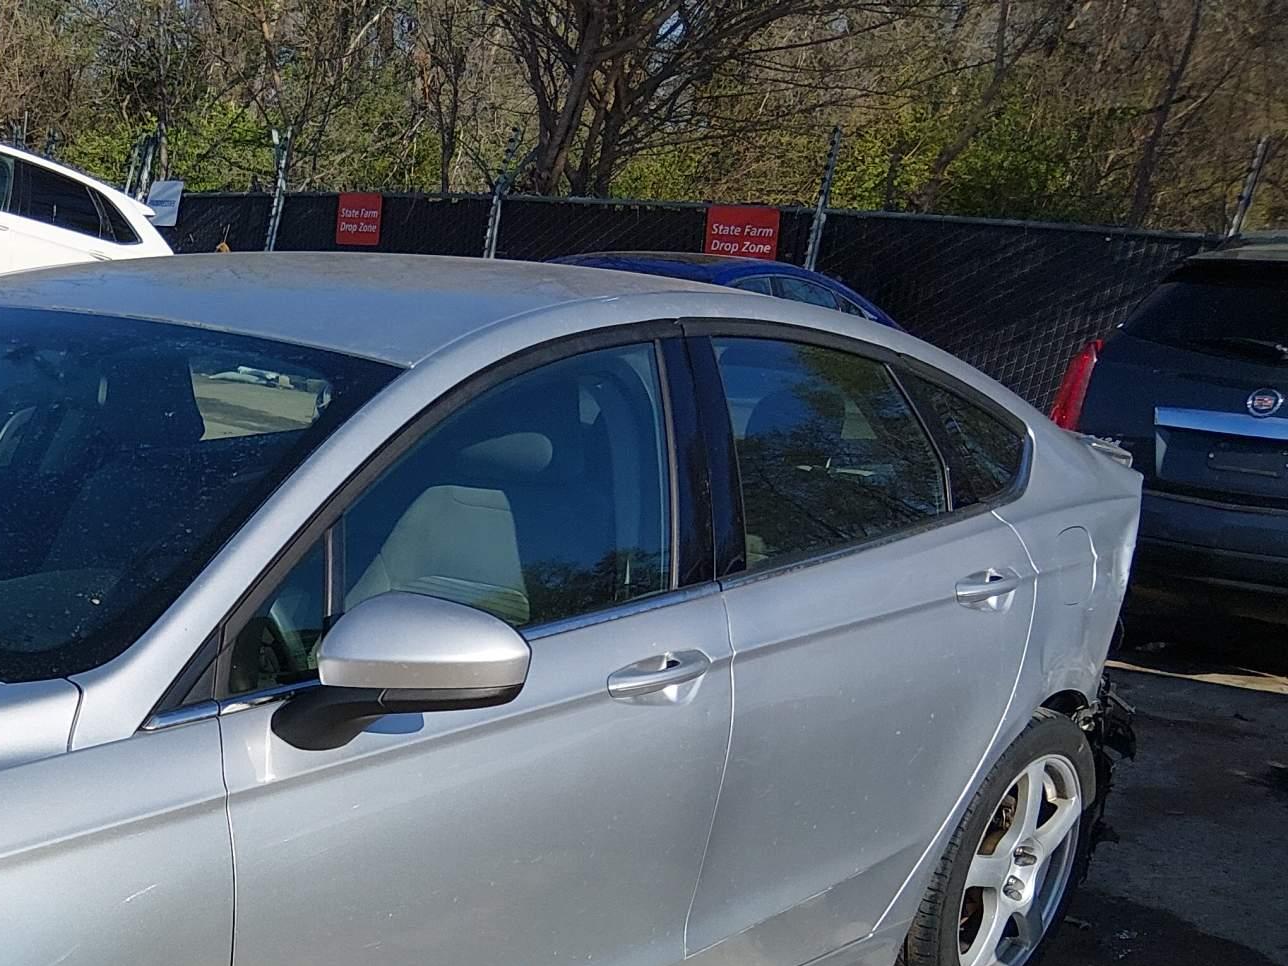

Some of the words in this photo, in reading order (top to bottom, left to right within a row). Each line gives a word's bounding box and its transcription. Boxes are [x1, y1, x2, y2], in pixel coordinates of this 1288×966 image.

[341, 207, 360, 218] State
[360, 208, 378, 219] Farm
[340, 221, 358, 234] Drop
[359, 222, 377, 233] Zone
[711, 223, 741, 236] State
[743, 225, 774, 237] Farm
[711, 239, 739, 254] Drop
[741, 241, 772, 254] Zone
